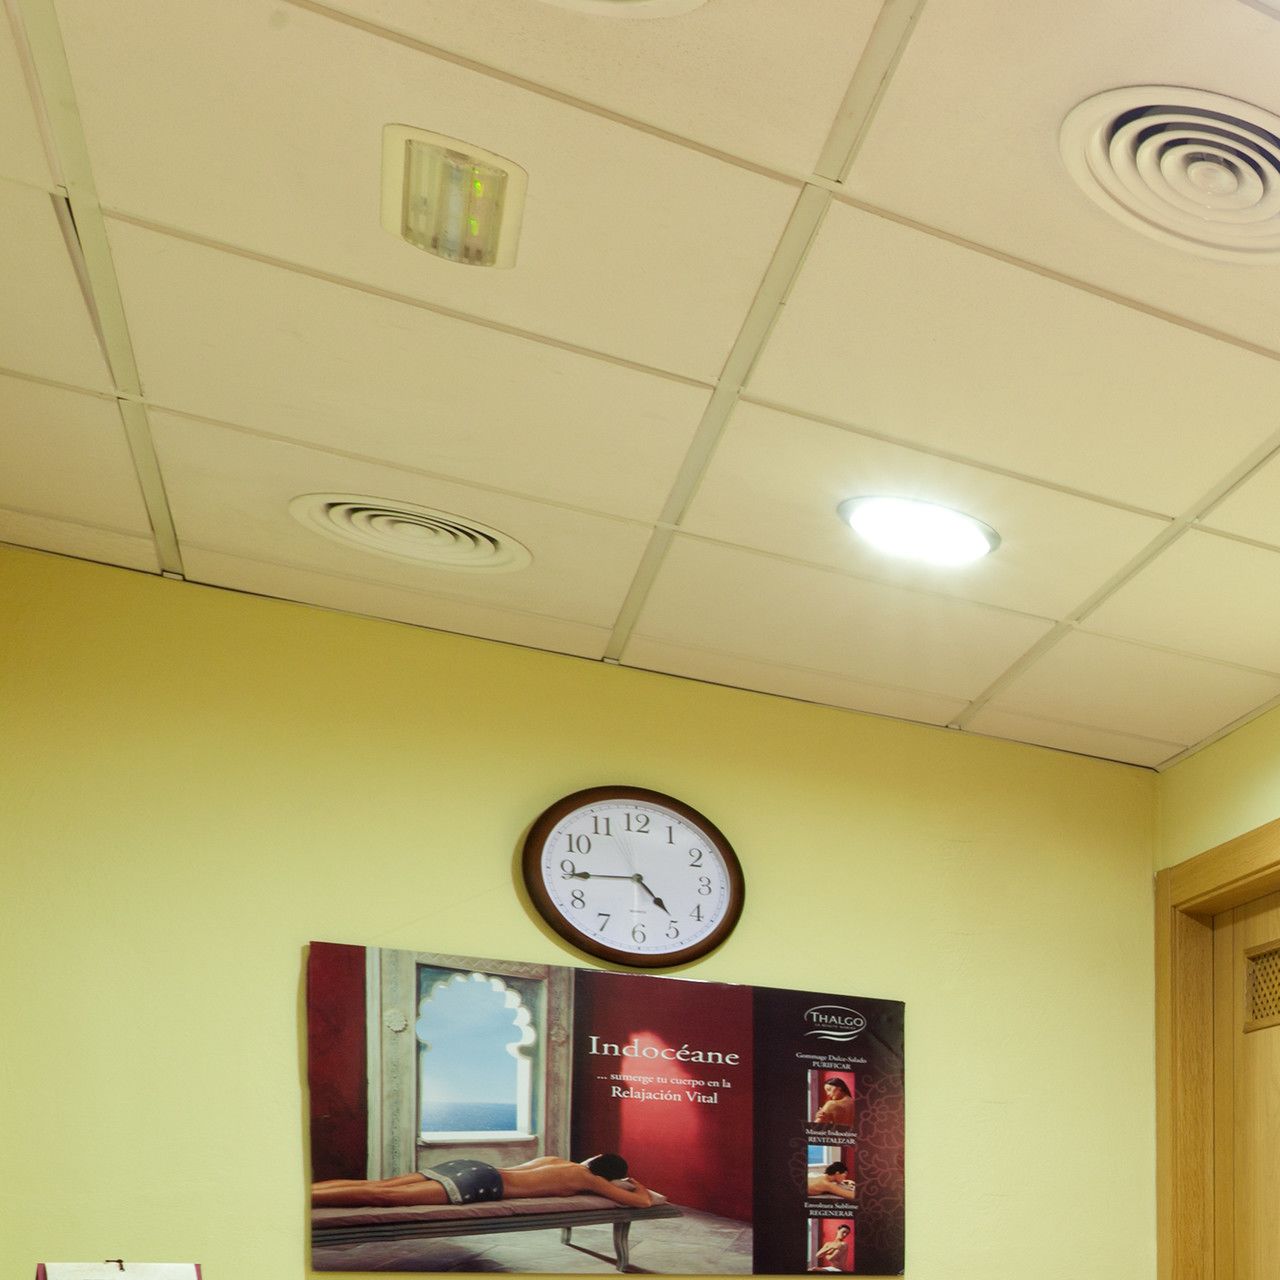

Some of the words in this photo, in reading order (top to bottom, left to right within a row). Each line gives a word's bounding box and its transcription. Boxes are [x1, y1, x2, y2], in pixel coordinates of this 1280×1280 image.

[592, 815, 612, 837] 11
[624, 813, 650, 834] 12
[567, 833, 592, 855] 10
[666, 826, 675, 845] 1
[688, 848, 703, 868] 2
[560, 859, 576, 881] 9
[697, 876, 712, 896] 3
[570, 889, 586, 910] 8
[597, 912, 611, 932] 7
[689, 904, 704, 922] 4
[631, 923, 647, 944] 6
[665, 920, 680, 940] 5
[810, 1011, 864, 1027] THALGO
[588, 1035, 740, 1065] Indocéane
[812, 1060, 851, 1070] PURIFICAR
[610, 1073, 653, 1086] sumerge
[656, 1075, 668, 1084] tu
[670, 1077, 705, 1088] cuerpo
[707, 1079, 720, 1088] en
[722, 1078, 732, 1089] la
[611, 1086, 682, 1102] Relajación
[685, 1090, 718, 1104] Vital
[808, 1136, 856, 1145] REVITALIZAR
[809, 1209, 854, 1217] REGENERAR
